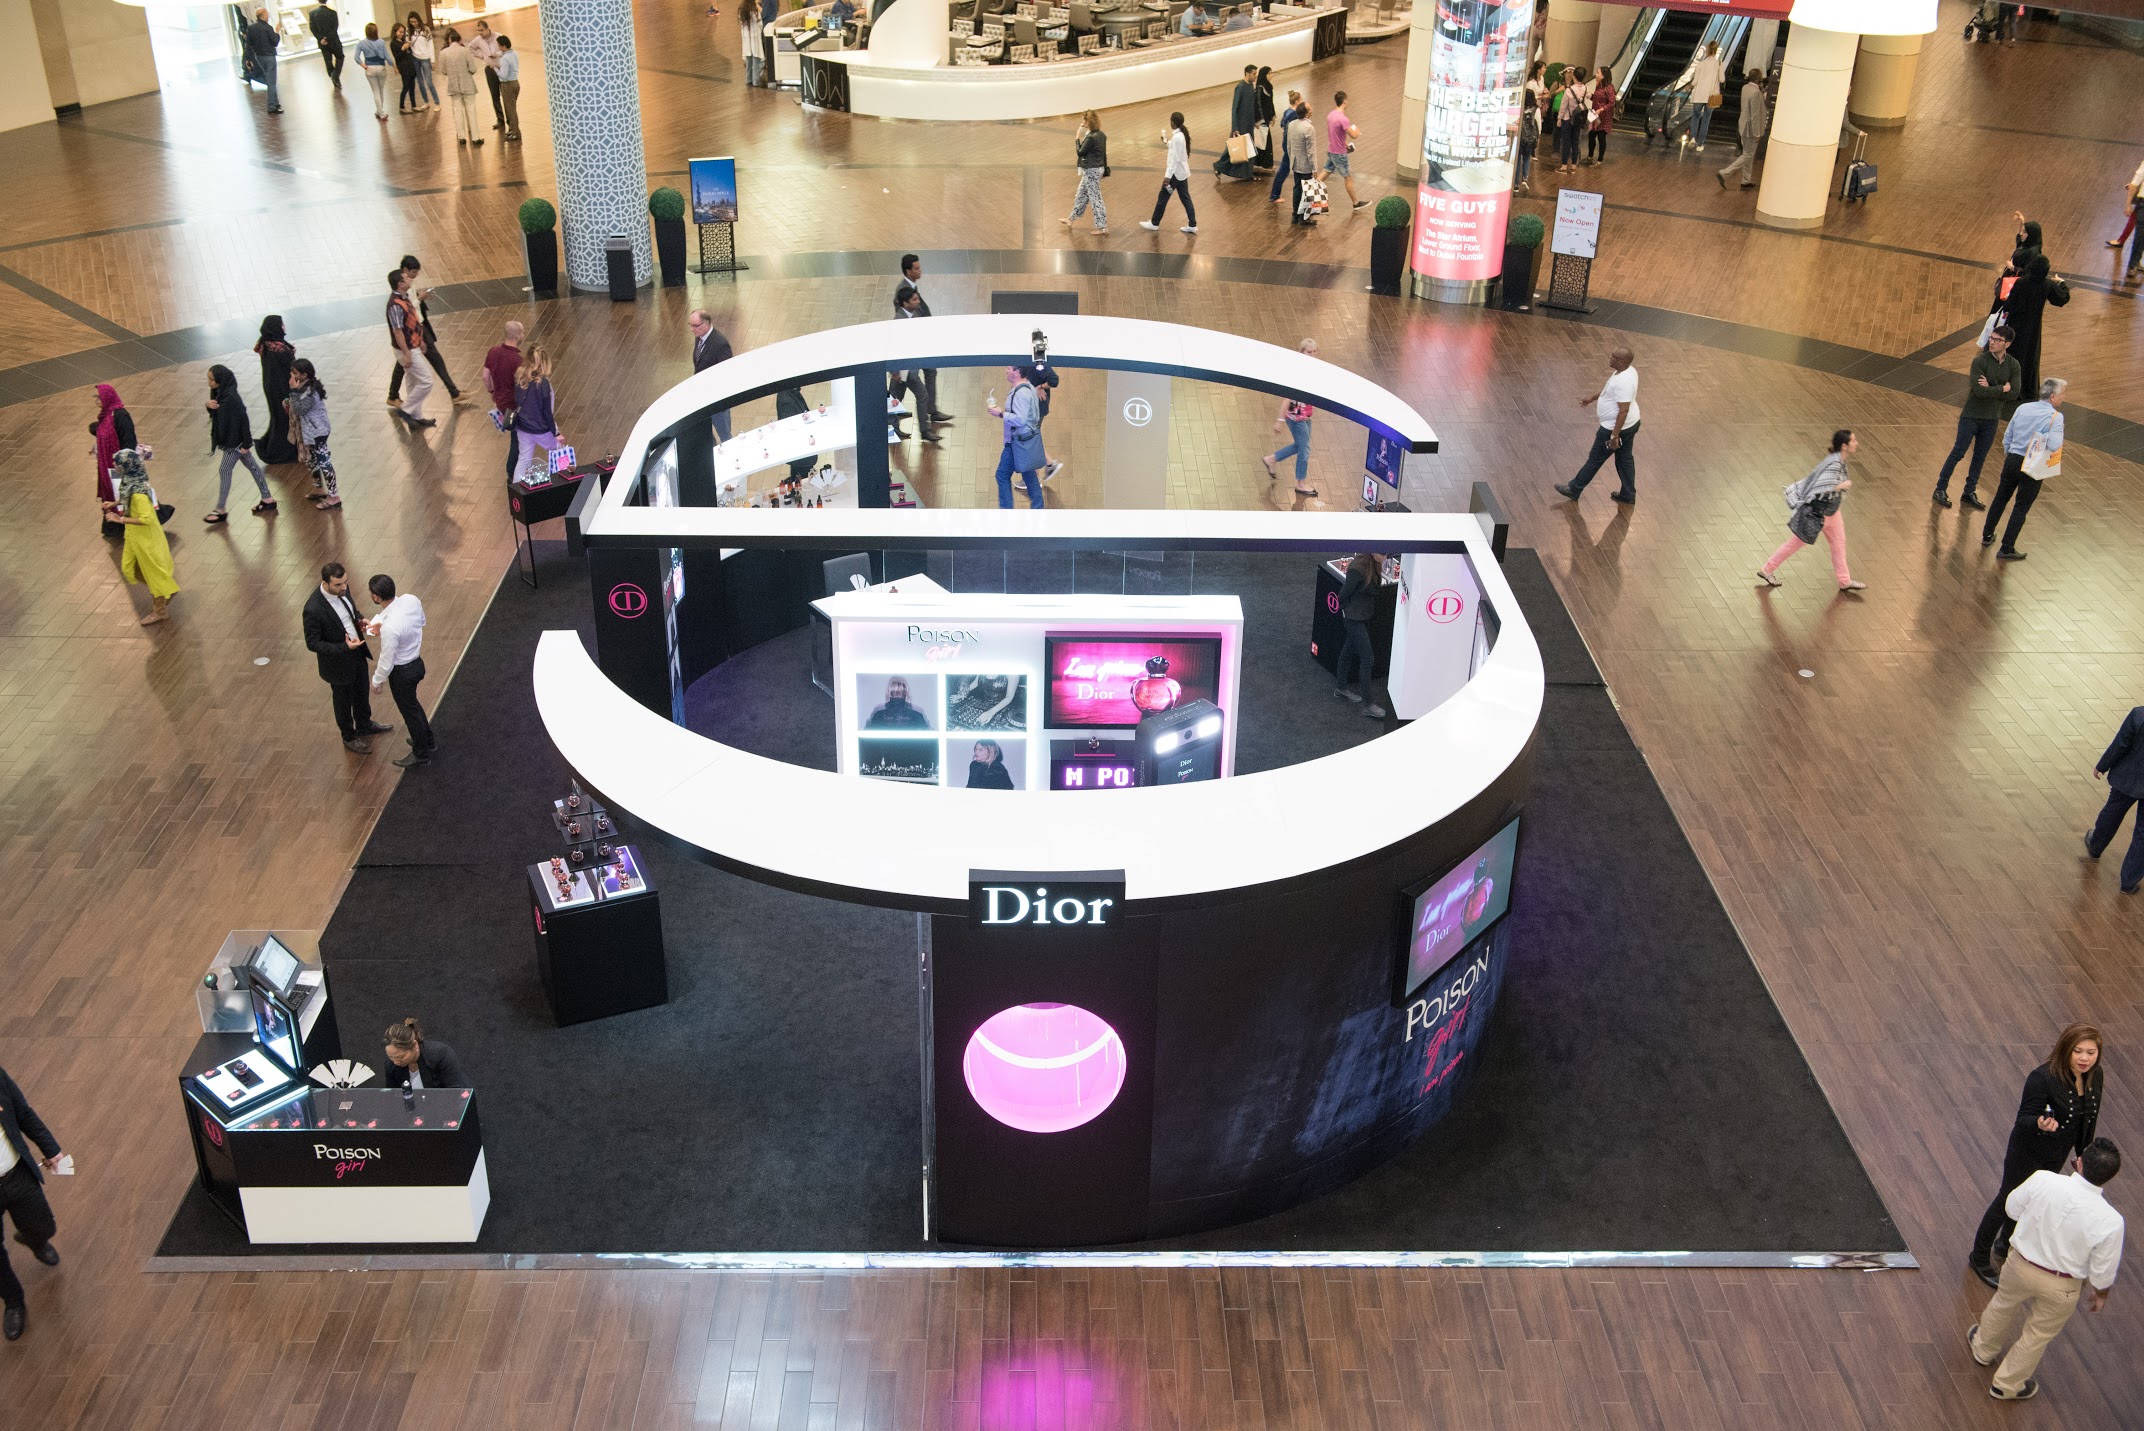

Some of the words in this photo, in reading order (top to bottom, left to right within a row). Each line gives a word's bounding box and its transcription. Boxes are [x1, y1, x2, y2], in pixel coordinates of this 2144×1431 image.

[803, 57, 844, 105] NOW
[1462, 90, 1512, 113] BEST
[1420, 192, 1447, 212] FIVE
[1451, 199, 1498, 214] GUYS
[1564, 192, 1589, 200] swatch
[1560, 216, 1574, 224] Now
[1576, 218, 1594, 227] Open
[1426, 228, 1436, 238] The
[1077, 684, 1115, 700] Dior
[982, 887, 1113, 924] Dior
[1424, 924, 1451, 953] Dior
[1405, 946, 1490, 1042] POISON
[1426, 994, 1470, 1077] girl
[313, 1144, 381, 1159] POISON
[335, 1160, 366, 1179] girl
